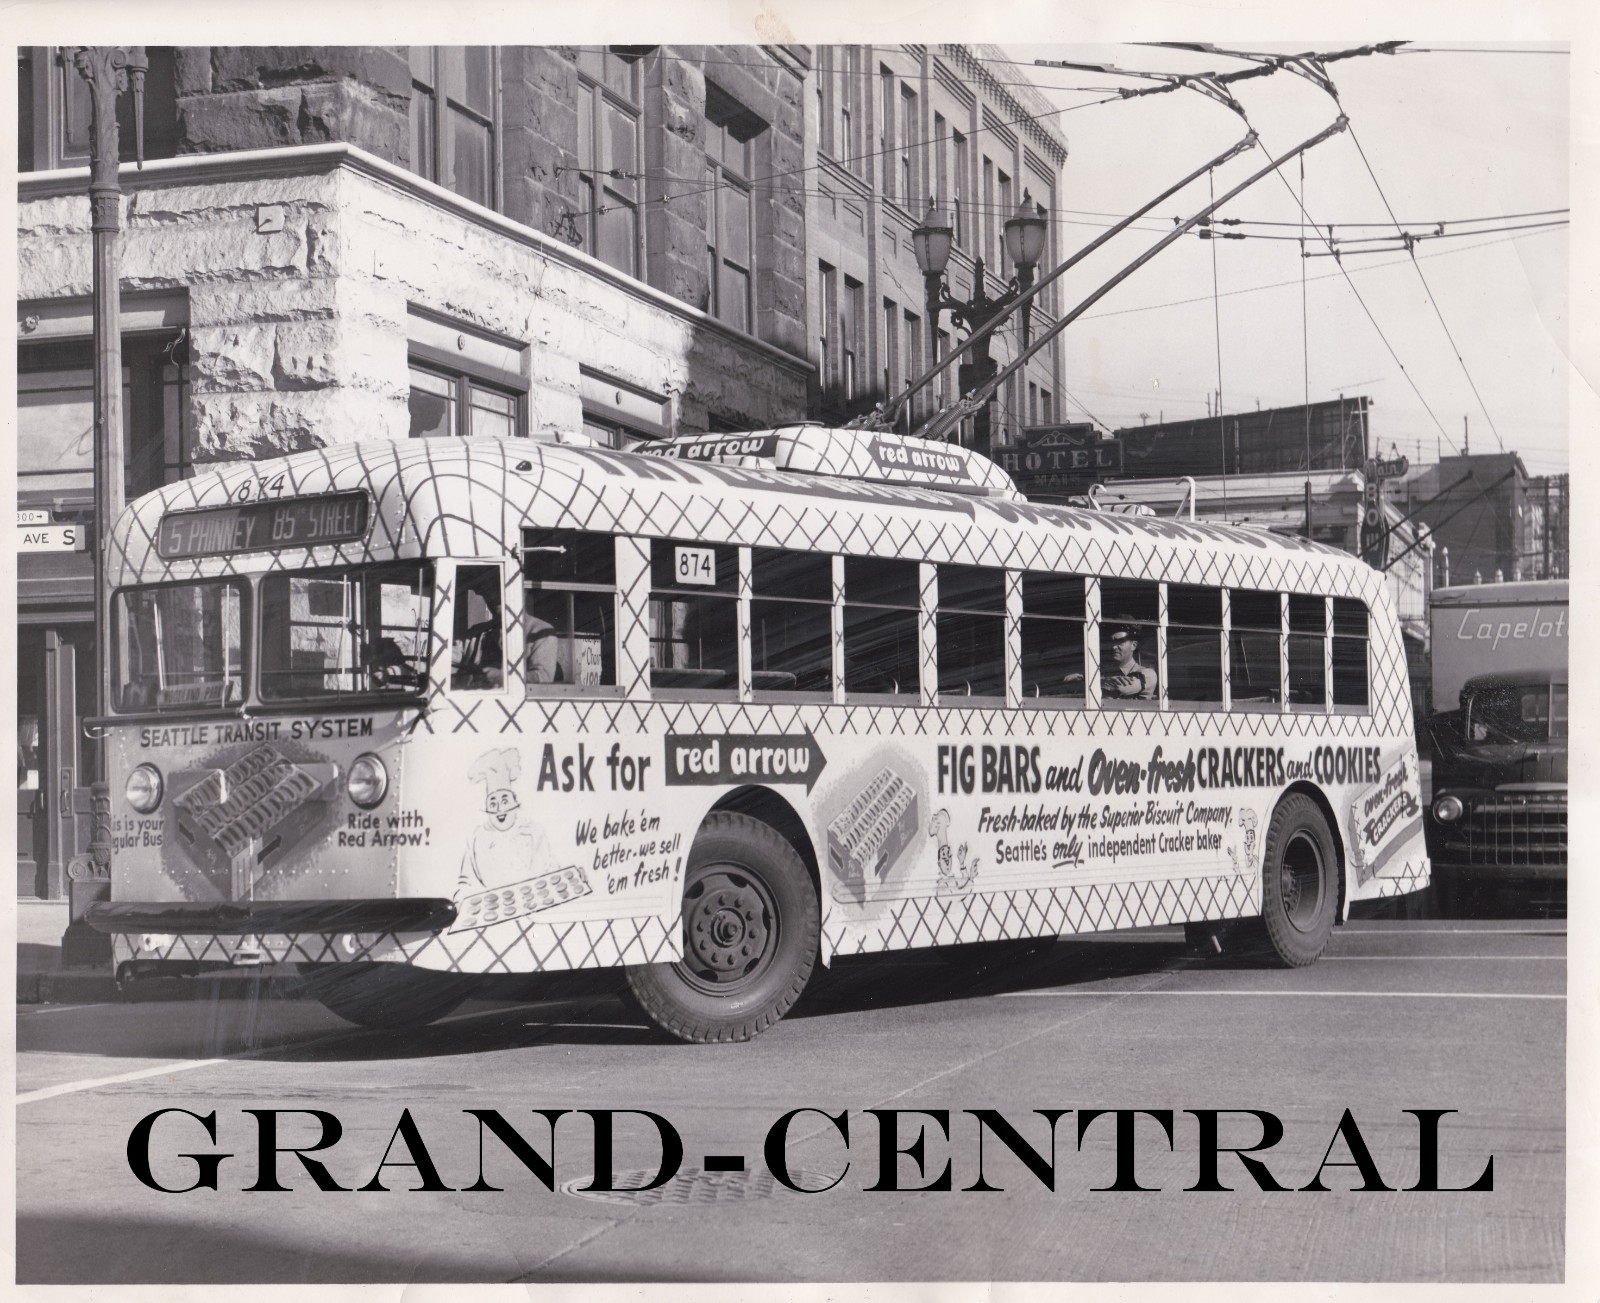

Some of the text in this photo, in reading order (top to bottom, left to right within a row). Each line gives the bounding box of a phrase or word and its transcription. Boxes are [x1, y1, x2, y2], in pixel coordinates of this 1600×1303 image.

[688, 438, 765, 459] arrow
[879, 443, 961, 473] red arrow
[1001, 449, 1112, 472] HOTEL
[238, 474, 285, 501] 874
[23, 529, 76, 546] AVE S
[169, 521, 184, 553] 5
[188, 516, 256, 553] PHINNEY
[307, 501, 362, 538] STREET
[679, 553, 711, 577] 874
[1457, 607, 1569, 651] Capelot
[140, 717, 373, 748] SEATTLE TRANSIT SYSTEM
[536, 742, 651, 792] Ask for
[675, 739, 811, 776] red arrow
[937, 745, 975, 794] FIG
[981, 745, 1042, 794] BARS
[1045, 754, 1084, 793] and
[1198, 746, 1286, 789] CRACKERS
[1286, 752, 1314, 781] and
[1314, 745, 1381, 785] COOKIES
[124, 814, 134, 831] is
[137, 819, 164, 836] your
[347, 810, 424, 830] Ride with
[575, 809, 660, 847] We bake 'em
[978, 804, 1059, 834] Fresh-baked
[1060, 804, 1077, 836] by
[1077, 804, 1098, 829] the
[1099, 804, 1143, 833] Superior
[1145, 801, 1184, 827] Biscuit
[1373, 795, 1408, 842] CRACKERS
[112, 831, 163, 855] gular Bus
[338, 828, 431, 847] Red Arrow!
[659, 833, 681, 855] sell
[996, 829, 1222, 868] Seattle's only independent Cracker baker
[606, 875, 628, 895] 'em
